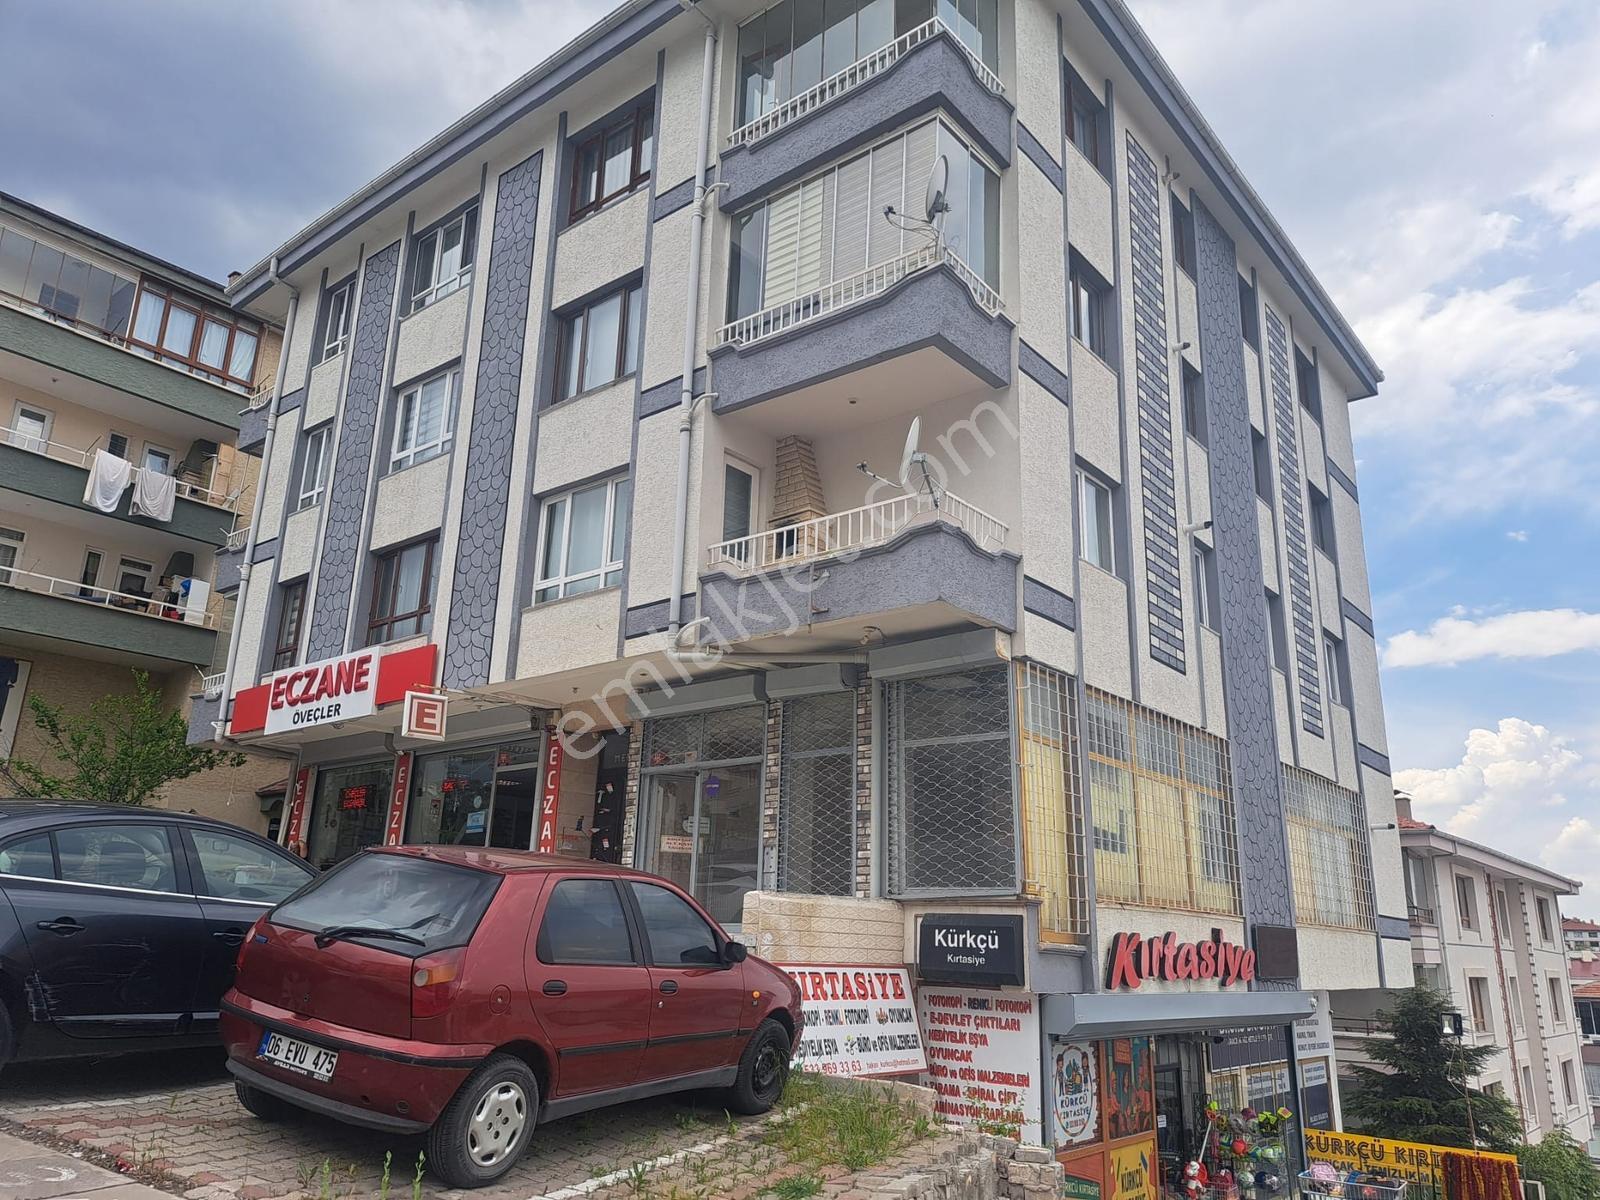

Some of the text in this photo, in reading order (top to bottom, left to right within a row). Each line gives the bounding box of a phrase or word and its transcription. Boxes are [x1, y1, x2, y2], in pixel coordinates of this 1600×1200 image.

[270, 654, 372, 711] ECZANE
[292, 703, 342, 725] ÖVEÇLER
[415, 702, 438, 731] E
[934, 928, 999, 954] Kürkçü
[947, 953, 986, 965] Kırtasiye
[1105, 927, 1256, 990] Kırtasiye
[928, 994, 963, 1009] FOTOKOPİ
[967, 996, 994, 1011] RENKLİ
[995, 1000, 1032, 1014] FOTOKOPİ
[888, 1007, 914, 1024] OYUNCAK
[929, 1011, 1021, 1032] E-DEVLET ÇIKTILARI
[968, 1032, 989, 1049] EŞYA
[267, 1035, 282, 1058] 06
[285, 1042, 309, 1066] EVU
[312, 1050, 337, 1074] 475
[929, 1046, 973, 1063] OYUNCAK
[840, 1061, 850, 1073] 33
[851, 1060, 862, 1073] 63
[929, 1062, 948, 1079] BÜRO
[959, 1065, 976, 1082] OFİS
